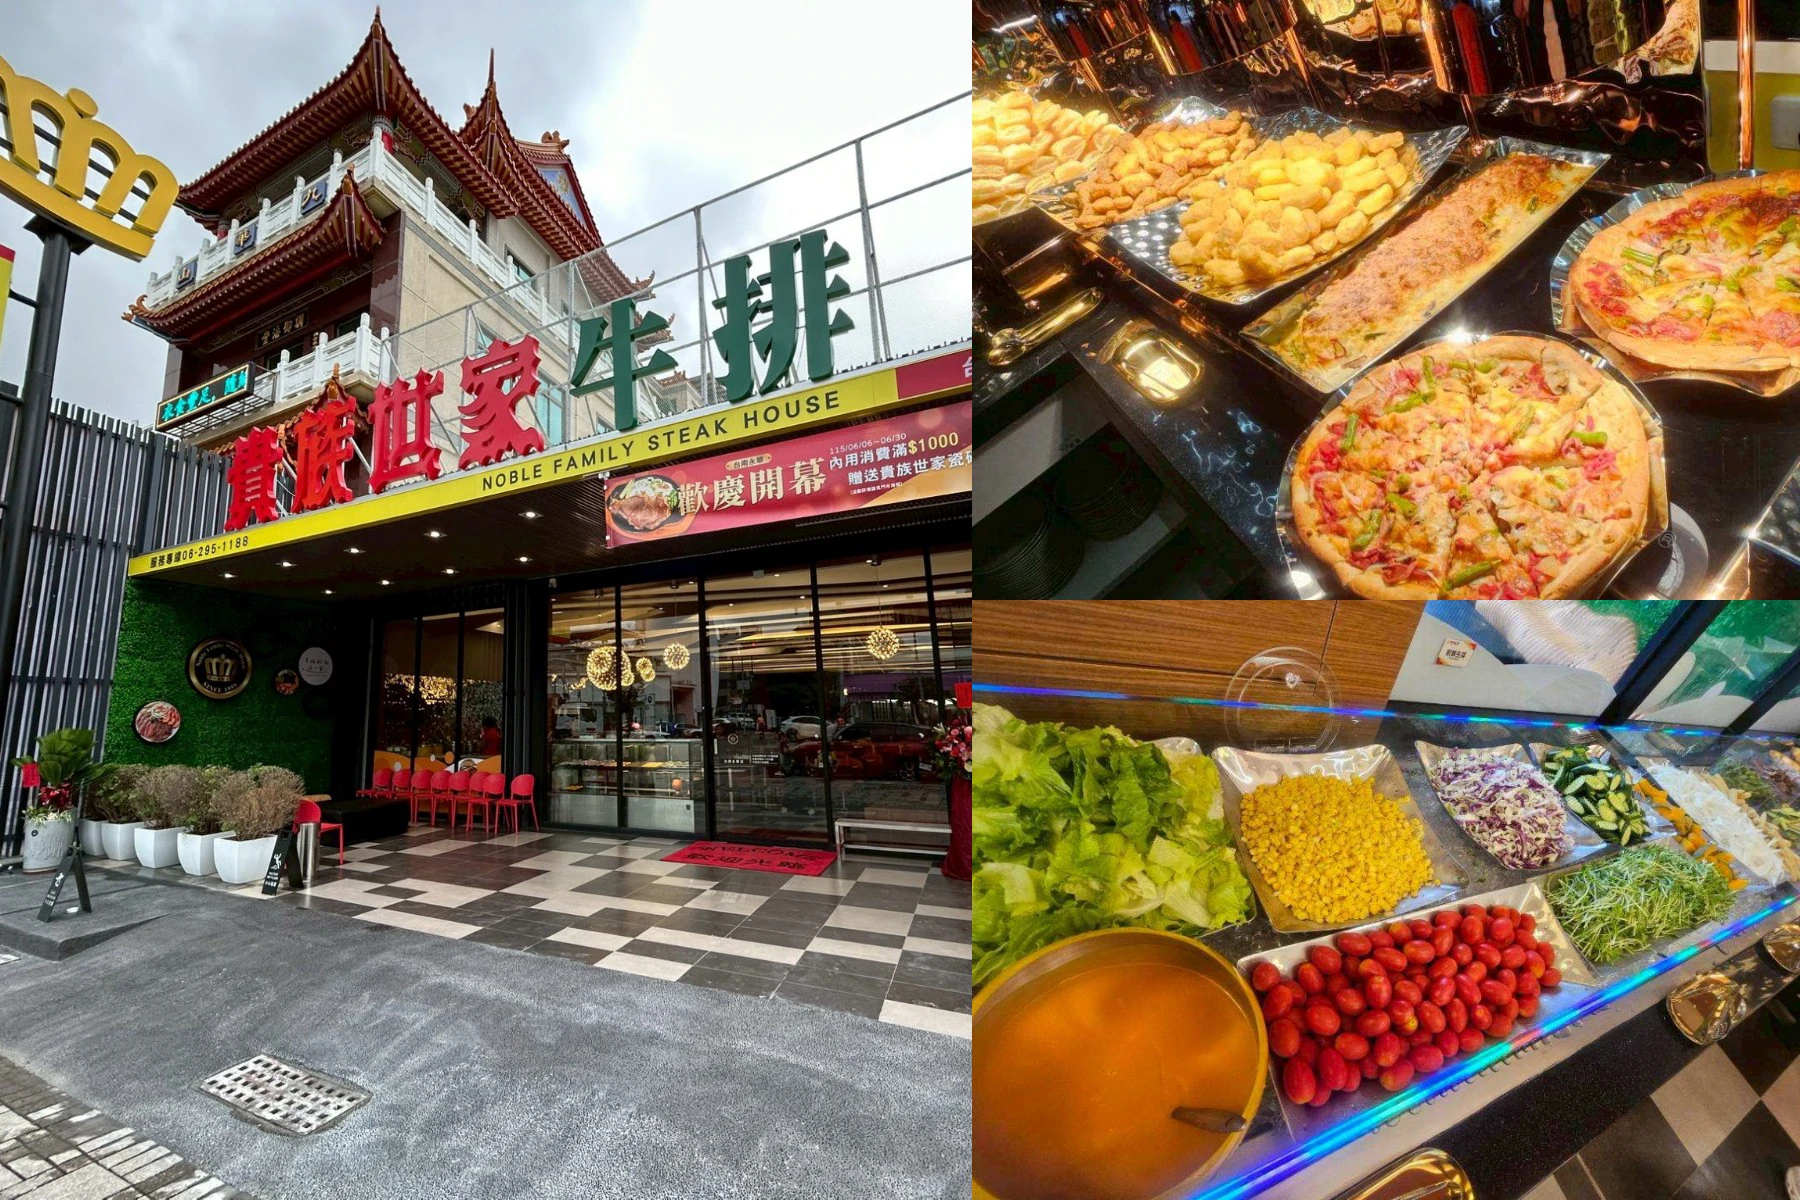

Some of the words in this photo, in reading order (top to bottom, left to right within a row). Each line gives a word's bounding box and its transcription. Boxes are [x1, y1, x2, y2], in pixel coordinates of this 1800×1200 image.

[482, 463, 543, 492] NOBLE
[553, 440, 636, 474] FAMILY
[647, 417, 729, 451] STEAK
[743, 390, 841, 429] HOUSE
[677, 456, 828, 517] 歡慶開幕
